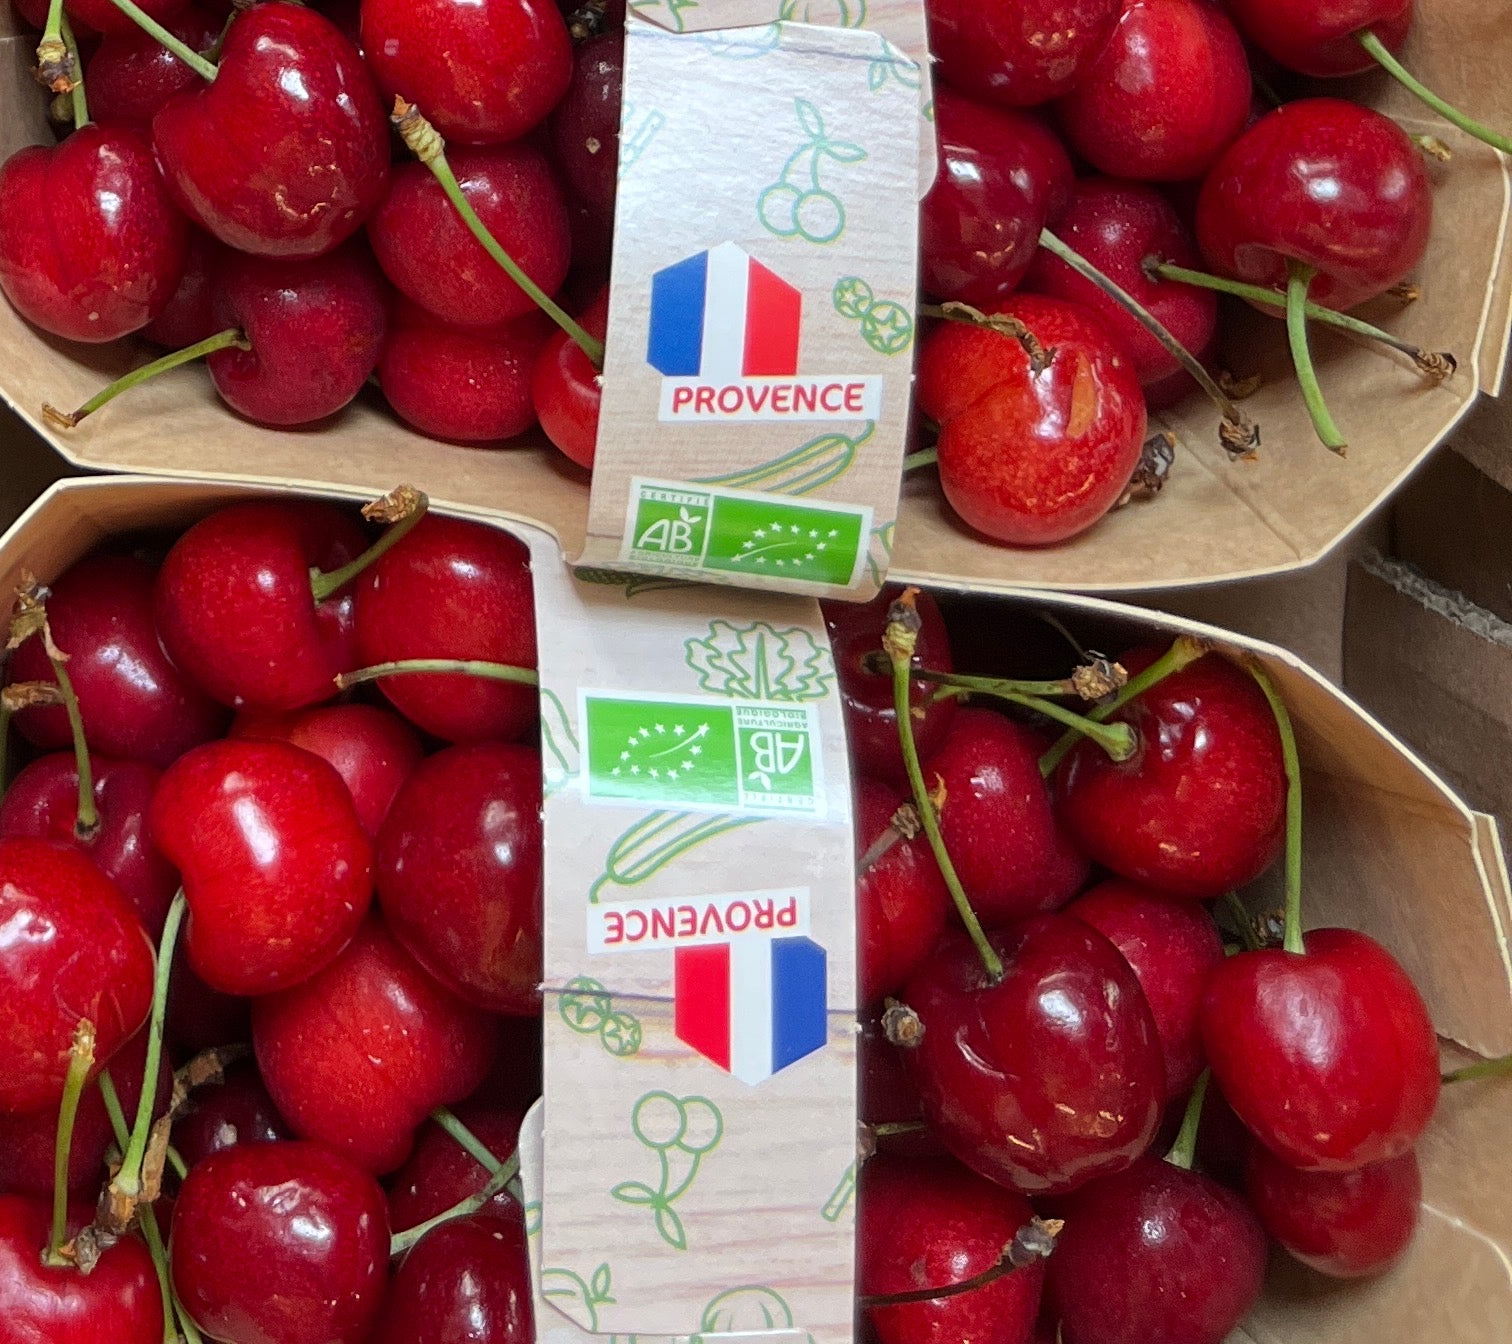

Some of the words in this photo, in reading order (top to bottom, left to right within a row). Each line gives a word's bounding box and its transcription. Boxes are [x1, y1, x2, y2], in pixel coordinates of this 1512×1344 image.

[671, 382, 866, 413] PROVENCE
[637, 518, 693, 553] AB
[736, 707, 807, 720] BIOLOGIQUE
[737, 718, 809, 729] AGRICULTURE
[749, 731, 805, 774] AB
[603, 896, 797, 943] PROVENCE
